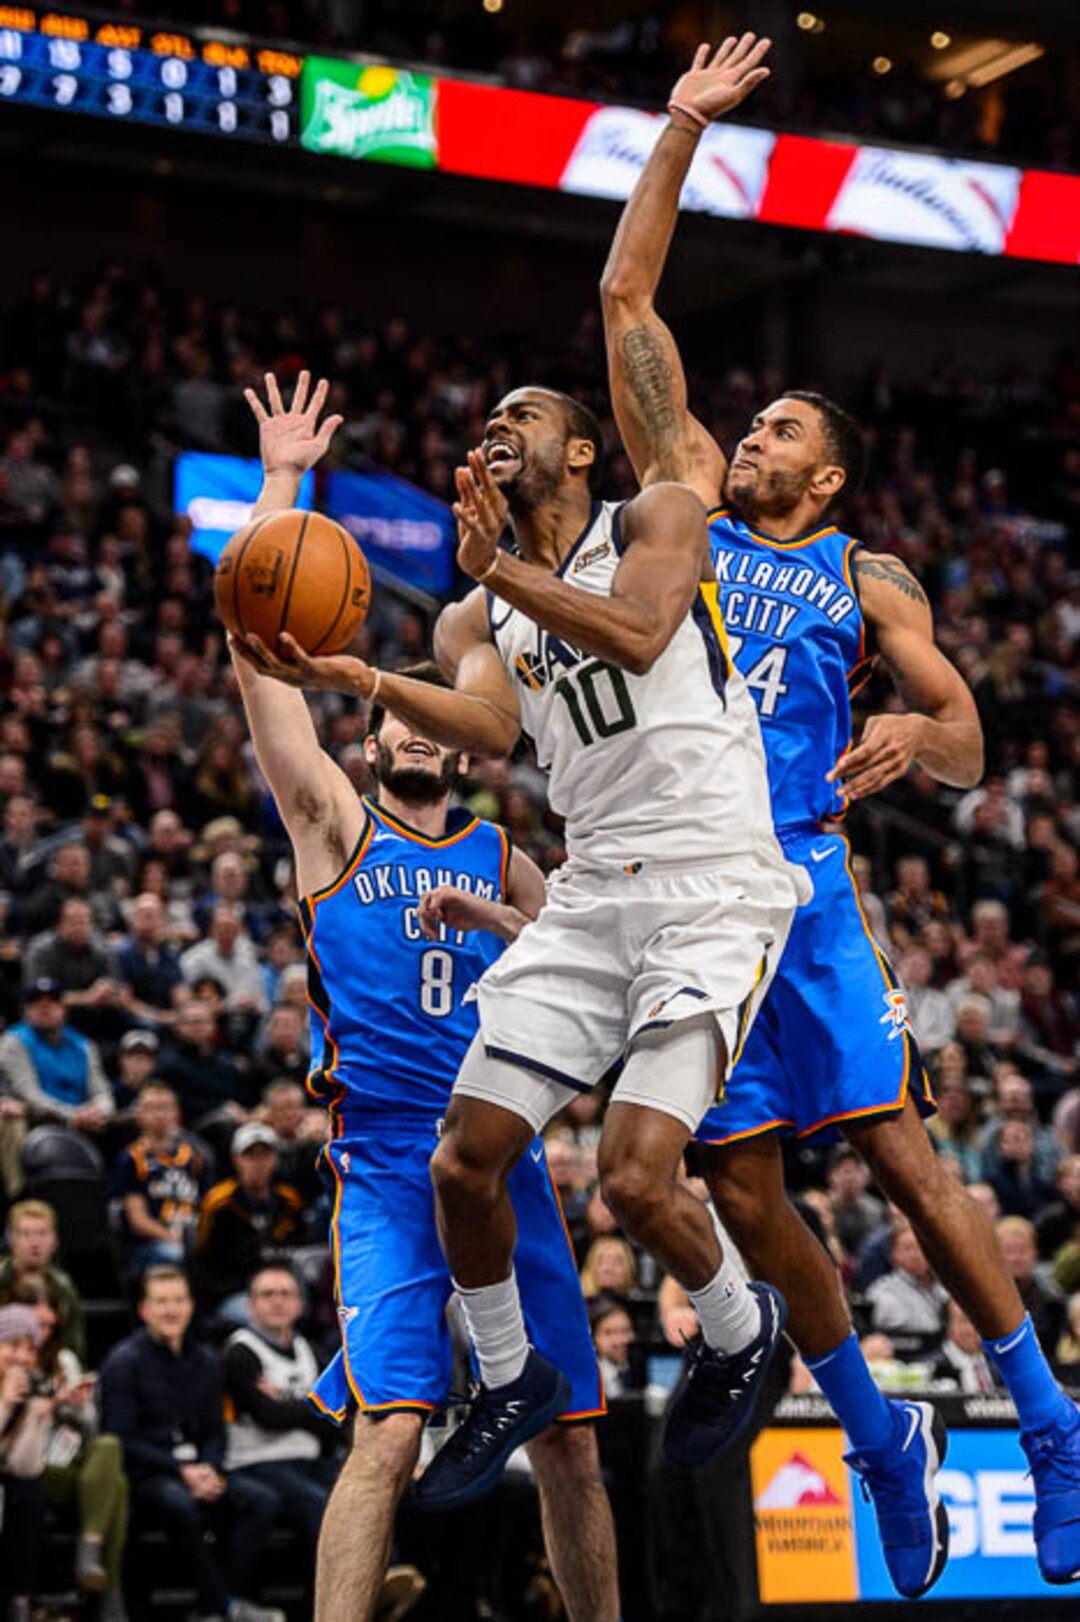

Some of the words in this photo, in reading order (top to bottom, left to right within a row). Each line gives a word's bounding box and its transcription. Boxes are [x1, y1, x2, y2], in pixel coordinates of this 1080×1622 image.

[715, 550, 855, 625] KLAHOMA
[725, 591, 798, 639] CITY
[555, 660, 637, 746] 10
[354, 865, 502, 904] OKLAHOM
[420, 949, 454, 1017] 8
